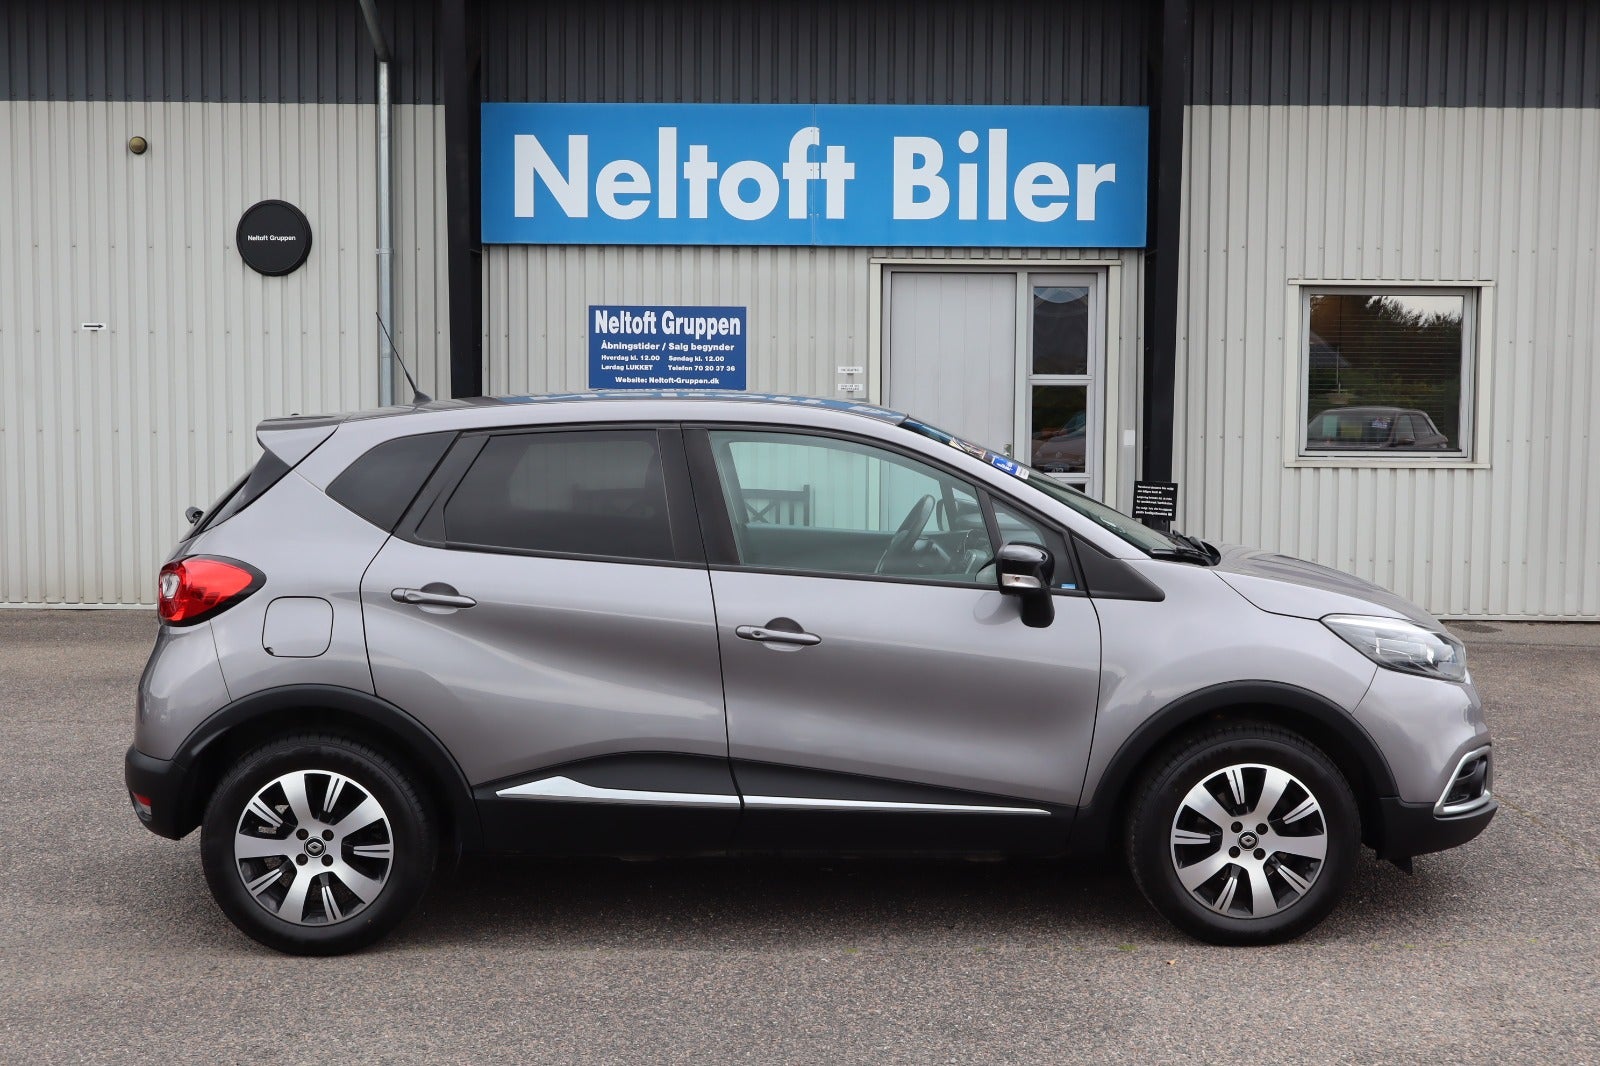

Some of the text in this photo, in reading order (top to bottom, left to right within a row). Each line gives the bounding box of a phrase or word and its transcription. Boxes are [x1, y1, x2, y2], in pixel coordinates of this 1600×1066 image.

[513, 126, 1117, 222] Neltoft Biler
[595, 310, 741, 340] Neltoft Gruppen
[601, 340, 660, 351] Åbningstider
[668, 342, 689, 352] Salg
[690, 343, 735, 352] begynder
[614, 376, 648, 384] Website:
